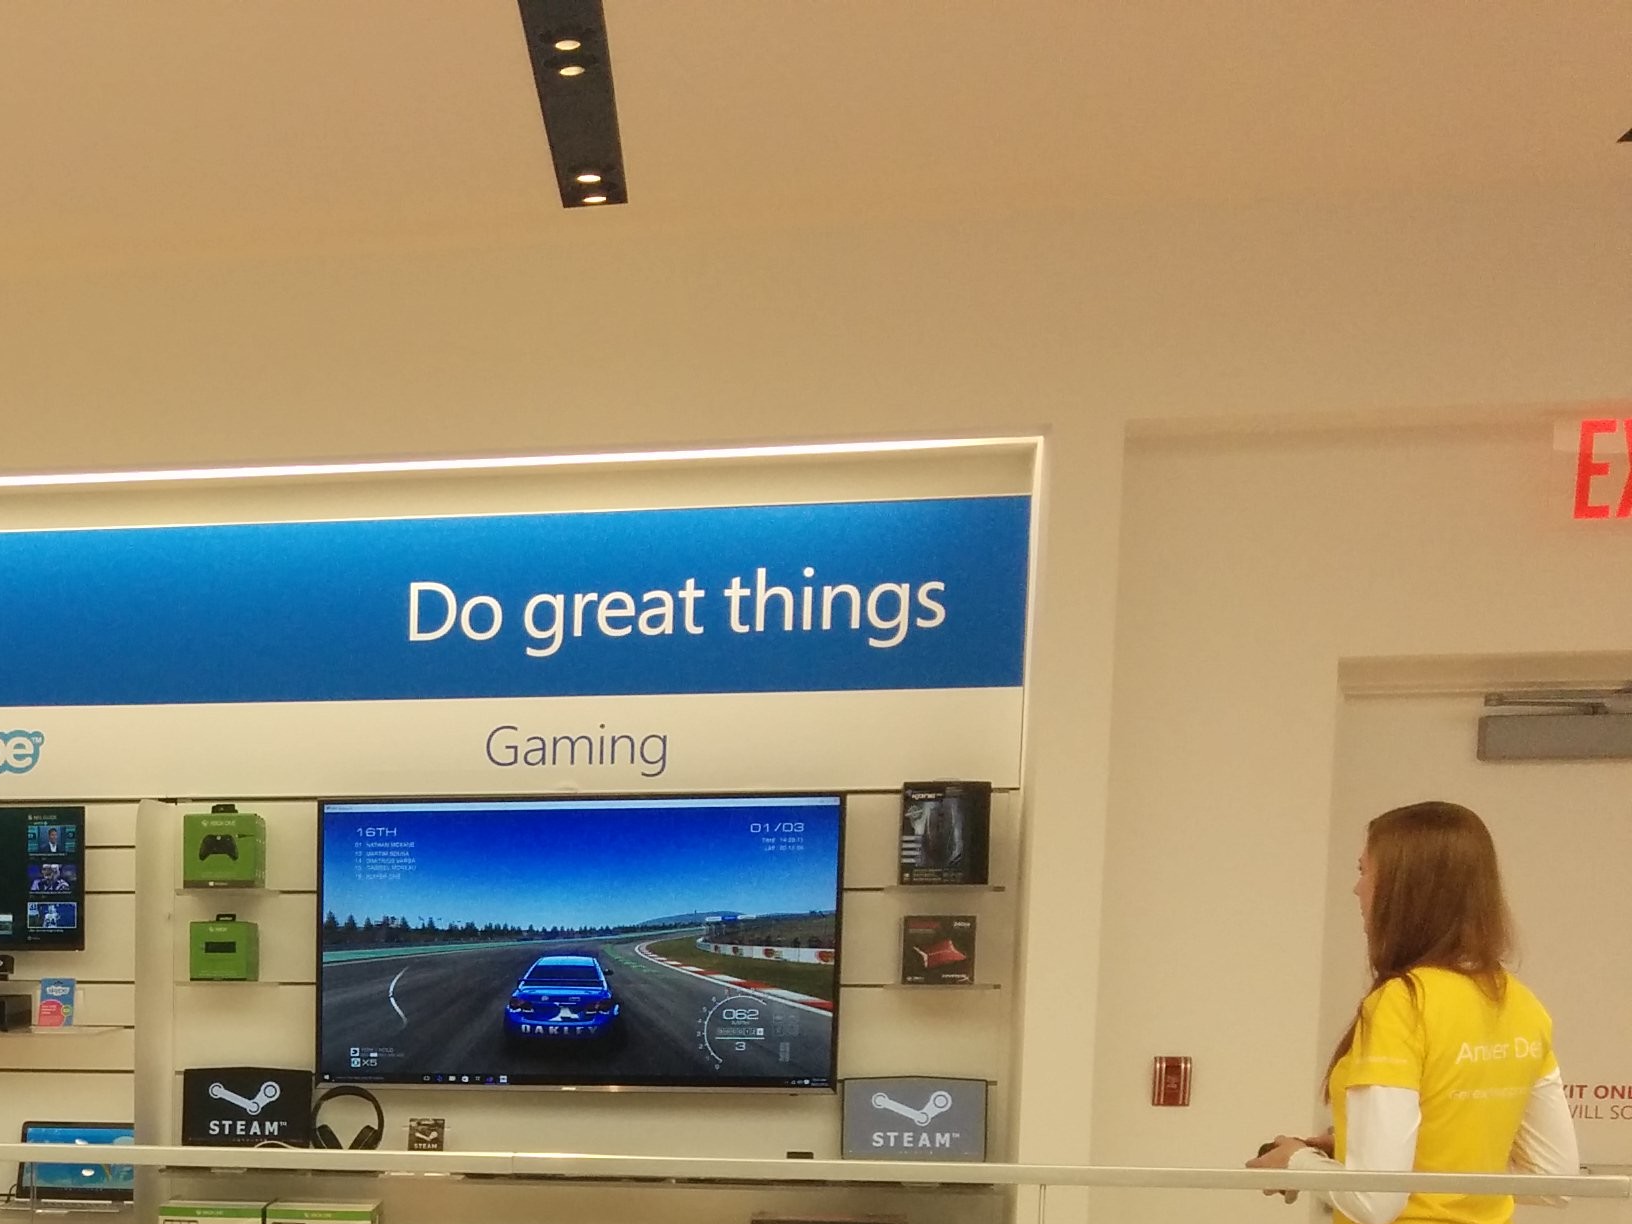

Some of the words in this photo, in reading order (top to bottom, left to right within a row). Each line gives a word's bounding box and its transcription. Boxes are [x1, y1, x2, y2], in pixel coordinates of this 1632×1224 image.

[408, 581, 503, 642] Do
[523, 577, 705, 658] great
[723, 567, 947, 648] things
[484, 724, 669, 778] Gaming
[356, 827, 397, 837] 16TH
[750, 823, 805, 833] 01/03
[722, 1009, 760, 1020] 062
[735, 1042, 746, 1051] 3
[1593, 1085, 1632, 1099] ONL
[209, 1120, 279, 1136] STEAM
[872, 1131, 951, 1148] STEAM
